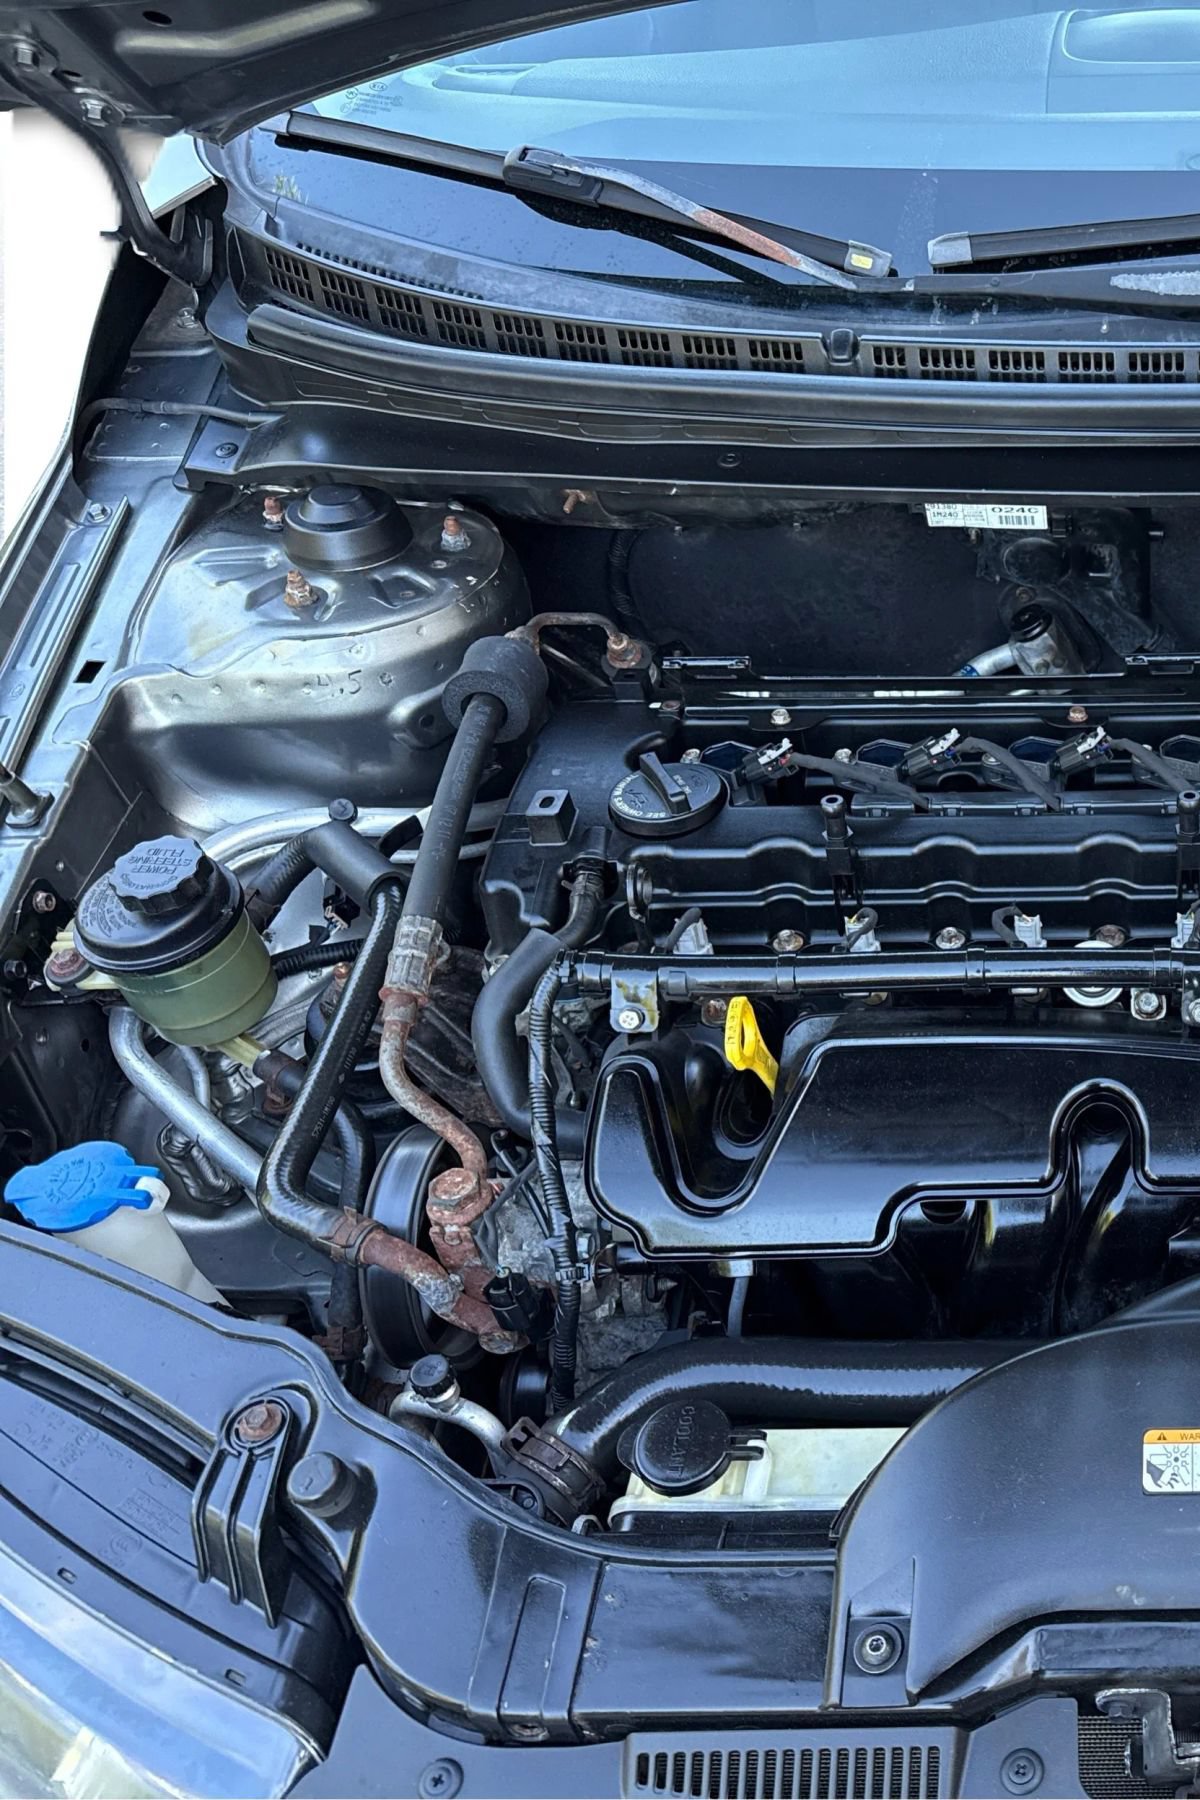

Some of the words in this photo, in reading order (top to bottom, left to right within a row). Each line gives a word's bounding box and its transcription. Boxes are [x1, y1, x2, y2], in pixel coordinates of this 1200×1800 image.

[147, 847, 185, 857] FLUID
[128, 855, 193, 868] STEERING
[131, 866, 178, 876] POWER
[667, 1405, 695, 1476] COOLANT
